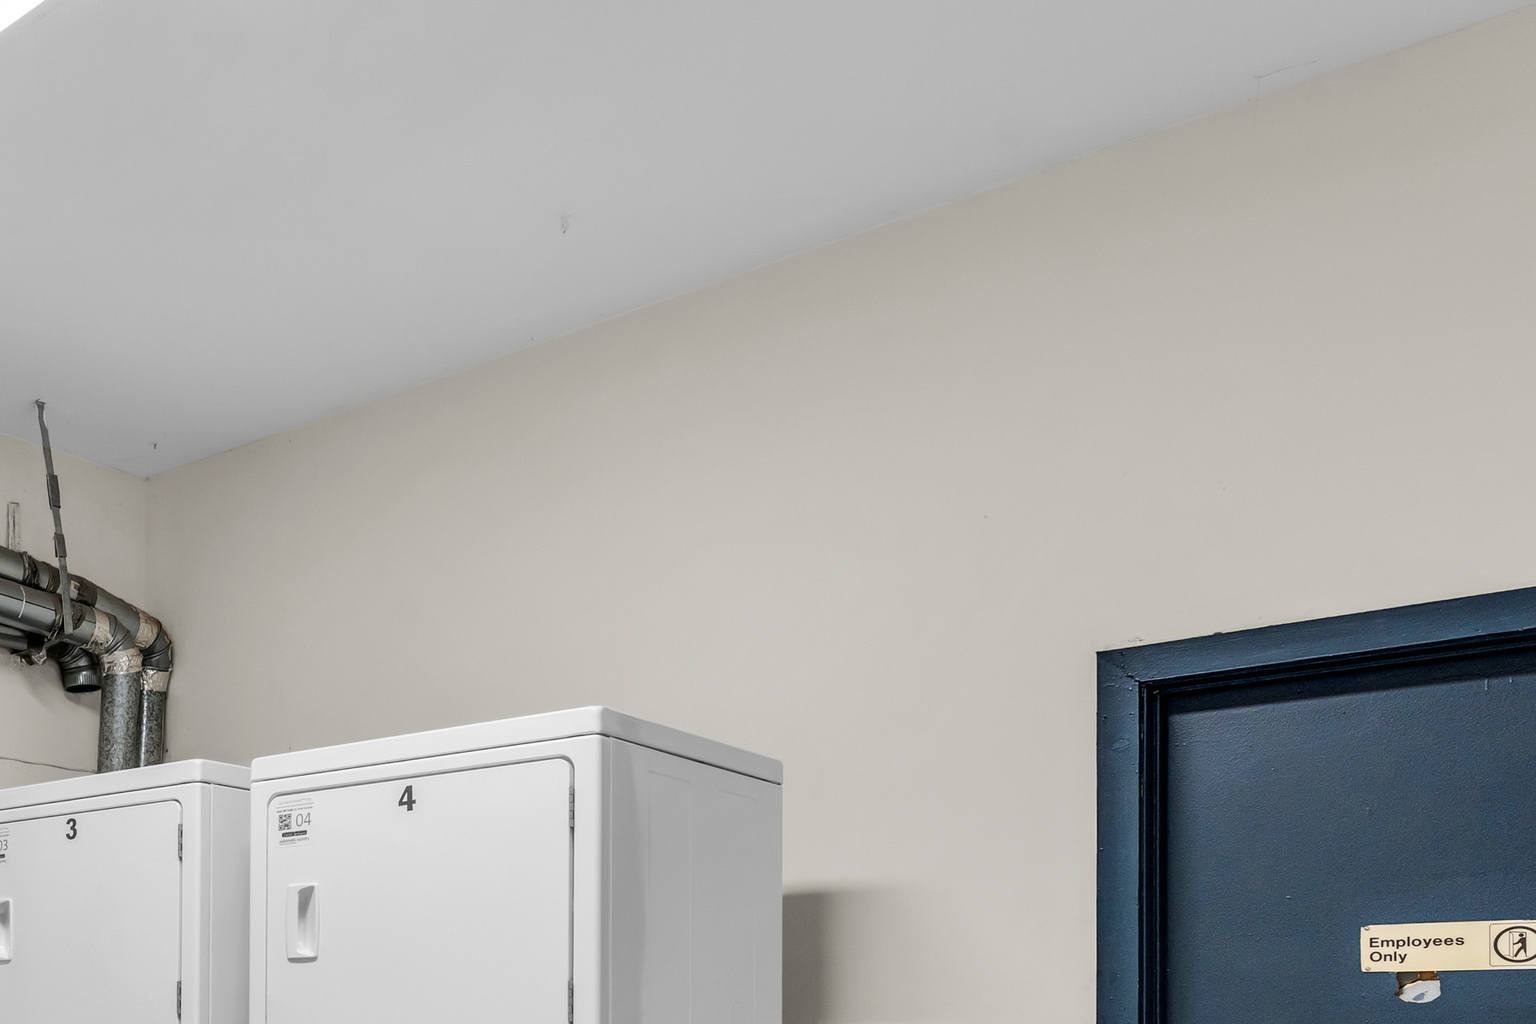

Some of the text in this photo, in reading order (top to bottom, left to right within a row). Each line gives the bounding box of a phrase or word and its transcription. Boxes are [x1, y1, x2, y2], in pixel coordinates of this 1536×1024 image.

[398, 785, 417, 812] 4
[295, 812, 311, 827] 04
[65, 818, 78, 840] 3
[1369, 936, 1465, 949] Employees
[1369, 951, 1408, 963] Only
